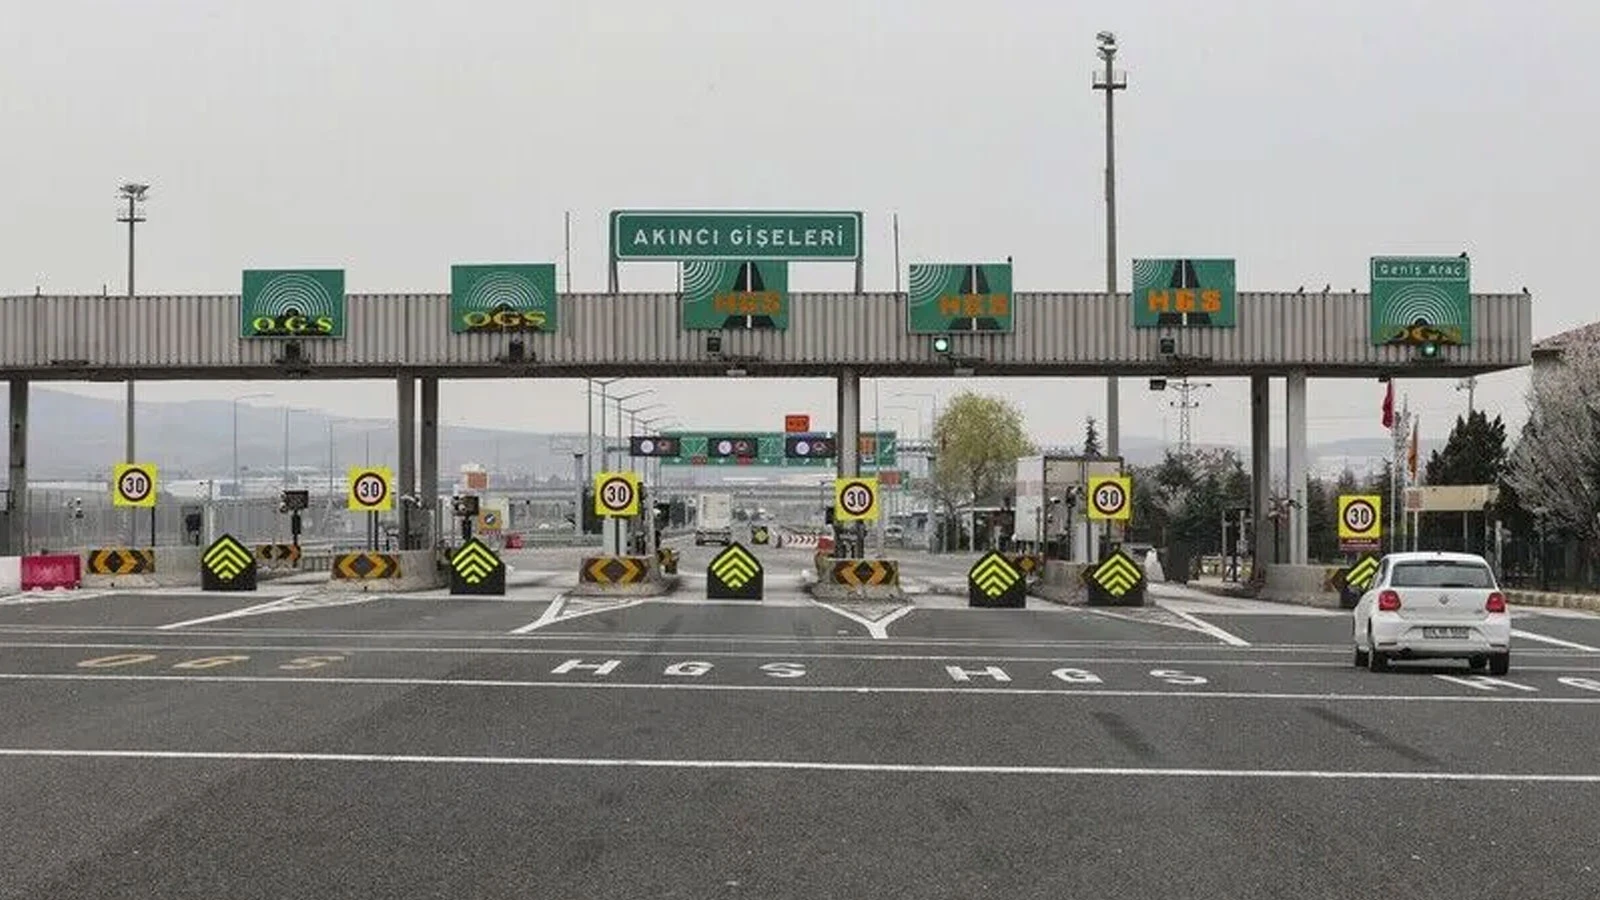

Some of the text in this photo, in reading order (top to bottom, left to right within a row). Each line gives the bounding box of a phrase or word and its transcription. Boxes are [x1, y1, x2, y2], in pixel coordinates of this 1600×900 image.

[633, 225, 843, 248] AKINCI GİŞELERİ
[1428, 264, 1461, 276] Araç
[1147, 288, 1221, 313] HGS
[253, 316, 333, 332] OGS
[463, 311, 546, 327] OGS
[126, 477, 145, 494] 30
[360, 481, 379, 498] 30
[607, 486, 626, 503] 30
[847, 490, 867, 507] 30
[1100, 490, 1119, 507] 30
[1350, 507, 1370, 525] 30
